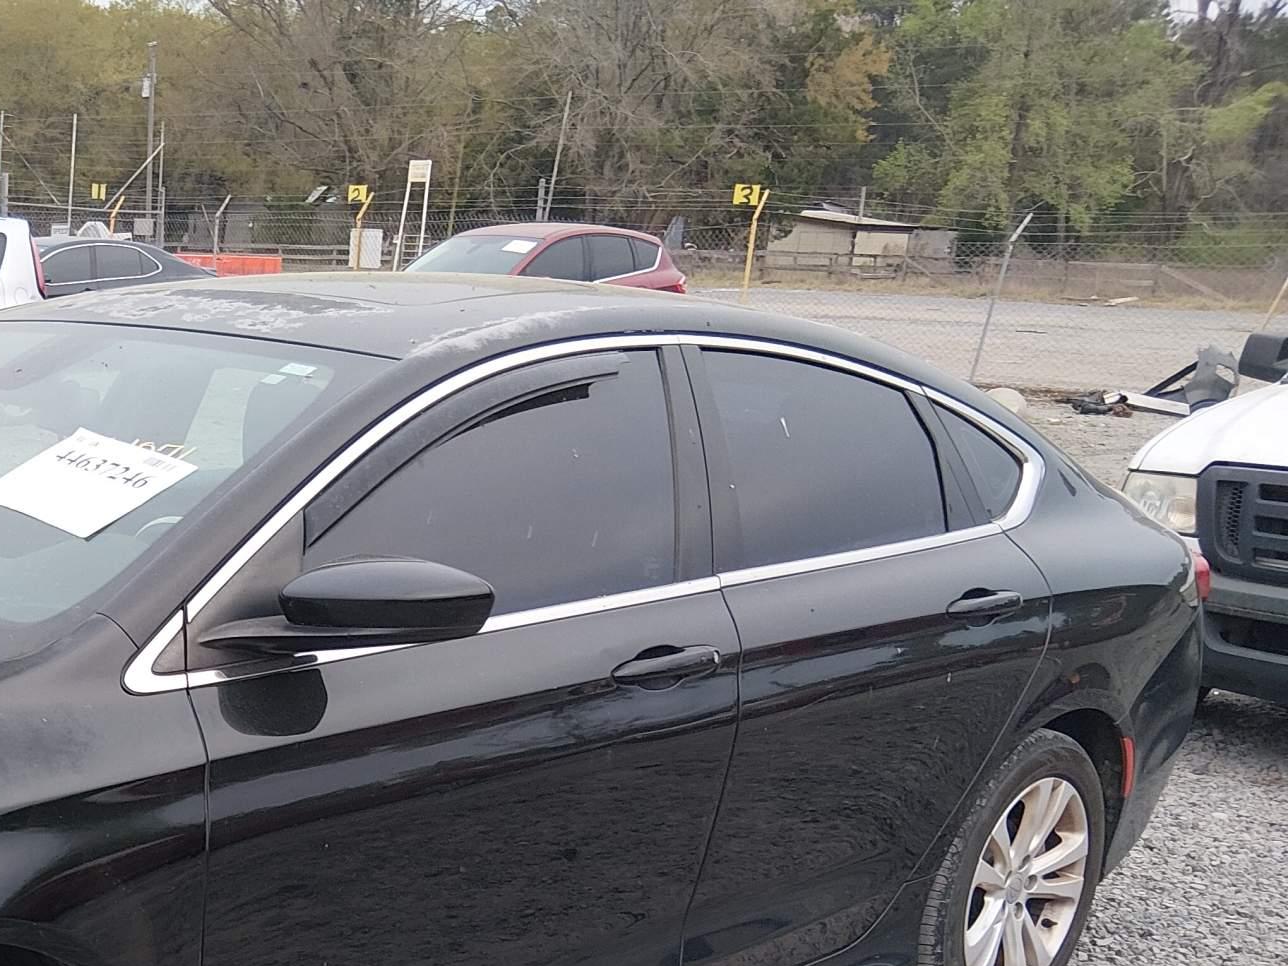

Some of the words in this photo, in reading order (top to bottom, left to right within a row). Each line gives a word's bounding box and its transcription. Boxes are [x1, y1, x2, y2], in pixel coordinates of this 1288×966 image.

[351, 187, 361, 201] 2
[740, 186, 754, 204] 3
[55, 449, 154, 489] 44637246
